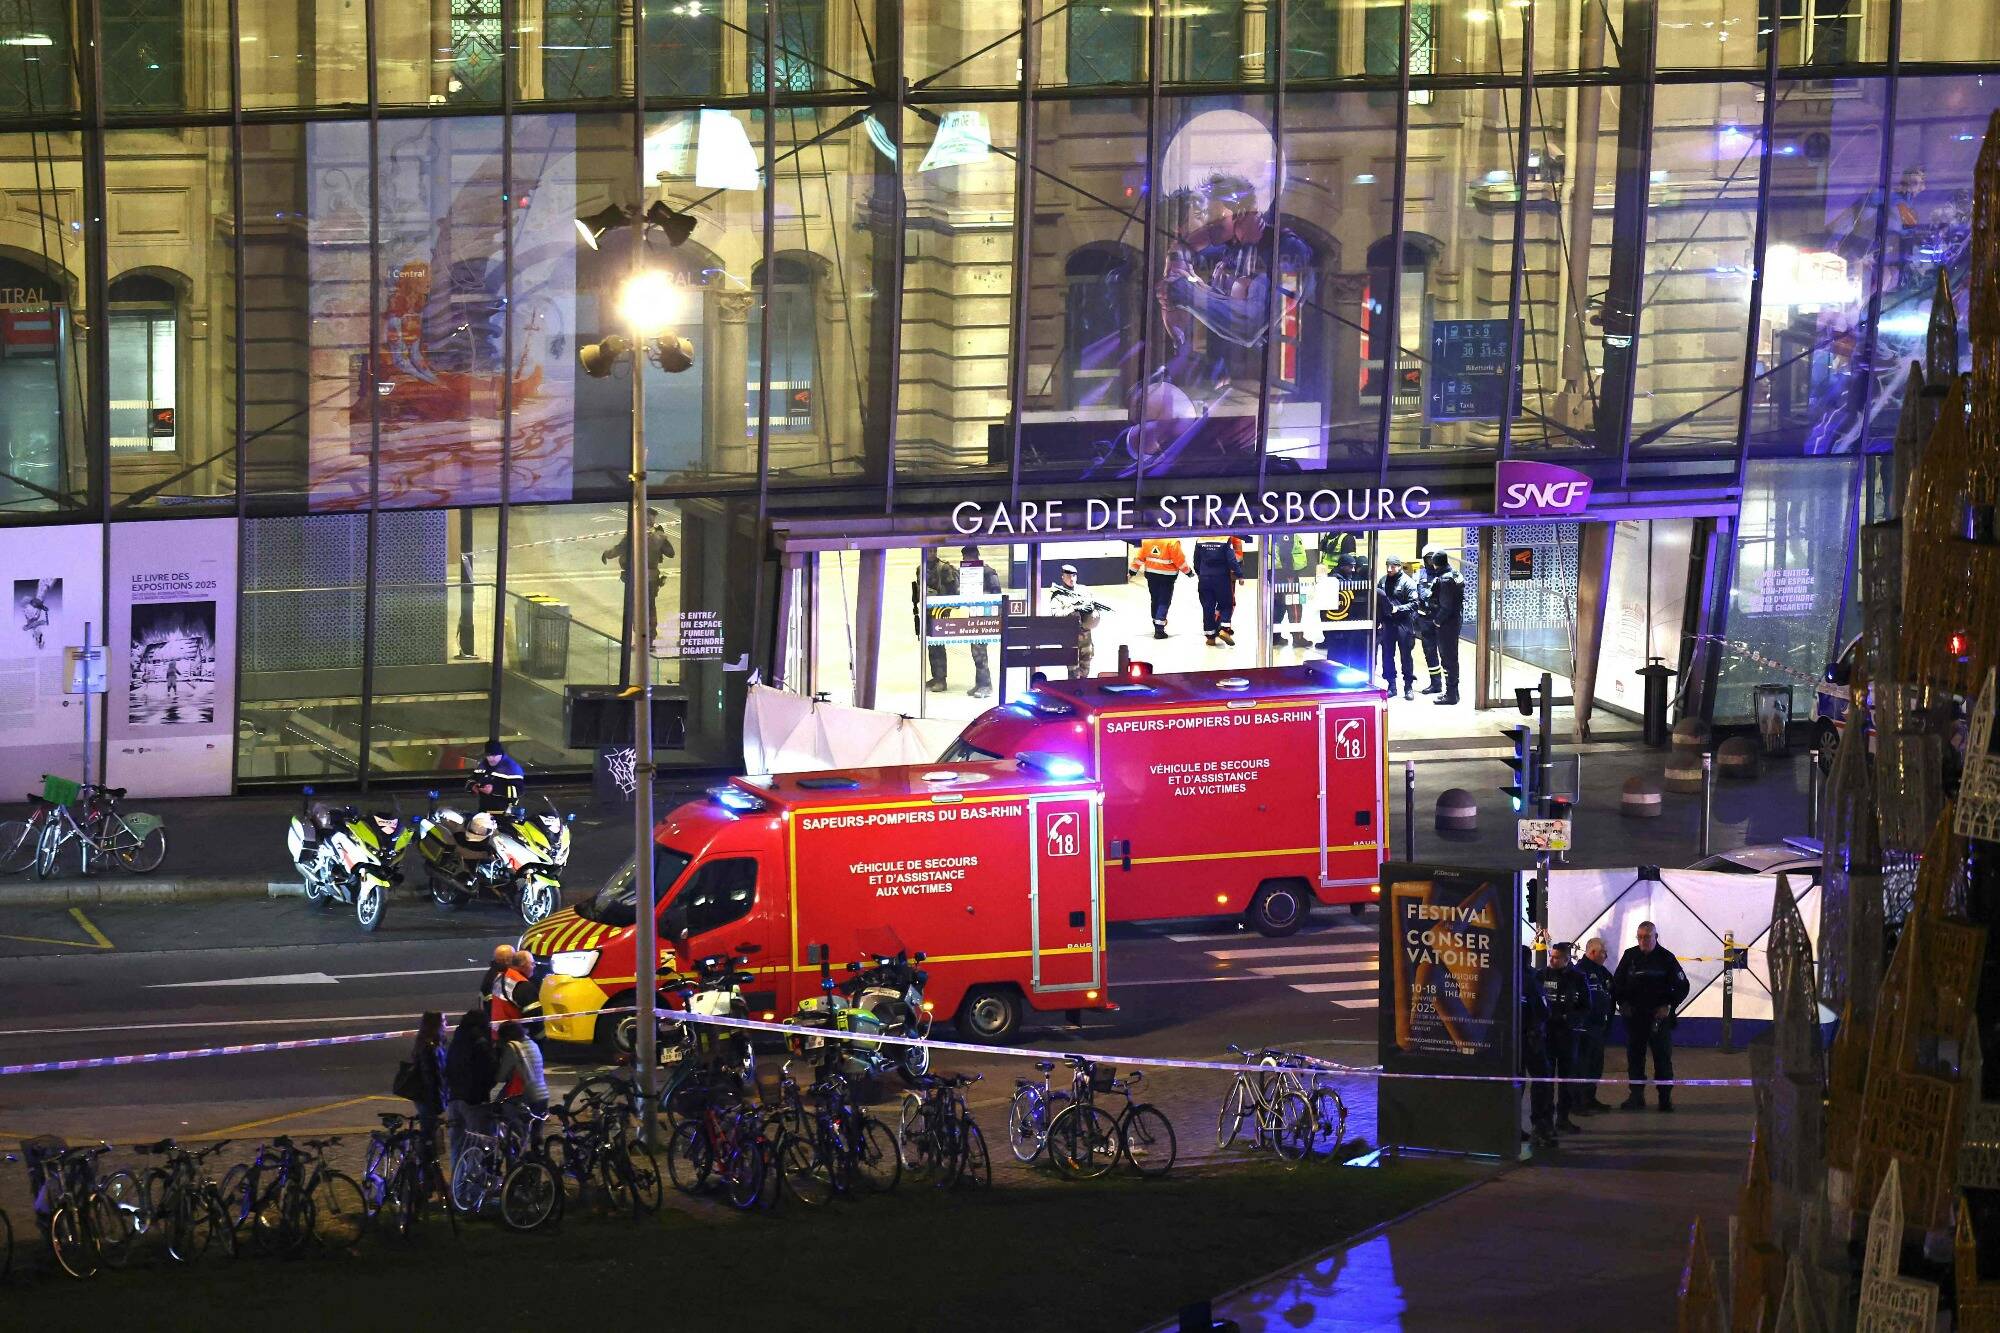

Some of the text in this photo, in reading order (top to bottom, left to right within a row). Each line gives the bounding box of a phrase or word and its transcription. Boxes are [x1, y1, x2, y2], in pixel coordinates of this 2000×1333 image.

[1502, 481, 1588, 509] SNCF
[951, 486, 1431, 535] GARE DE STRASBOURG
[132, 572, 190, 583] LE LIVRE DES
[131, 580, 217, 592] EXPOSITIONS 2025
[693, 620, 723, 628] ESPACE
[682, 646, 723, 655] CIGARETTE
[1106, 711, 1312, 733] SAPEURS-POMPIERS DU BAS-RHIN
[1343, 738, 1361, 758] 18
[1149, 758, 1270, 774] VÉHICULE DE SECOURS
[1168, 771, 1258, 785] ET D'ASSISTANCE
[1174, 783, 1247, 796] AUX VICTIMES
[802, 805, 1022, 830] SAPEURS-POMPIERS DU BAS-RHIN
[1055, 834, 1074, 854] 18
[849, 856, 978, 874] VÉHICULE DE SECOURS
[869, 870, 965, 885] ET D'ASSISTANCE
[876, 883, 953, 897] AUX VICTIMES
[1407, 903, 1491, 924] FESTIVAL
[1406, 929, 1490, 950] CONSER
[1406, 947, 1490, 969] VATOIRE
[1444, 972, 1479, 982] MUSIQUE
[1444, 981, 1469, 989] DANSE
[1410, 1003, 1436, 1013] 2025
